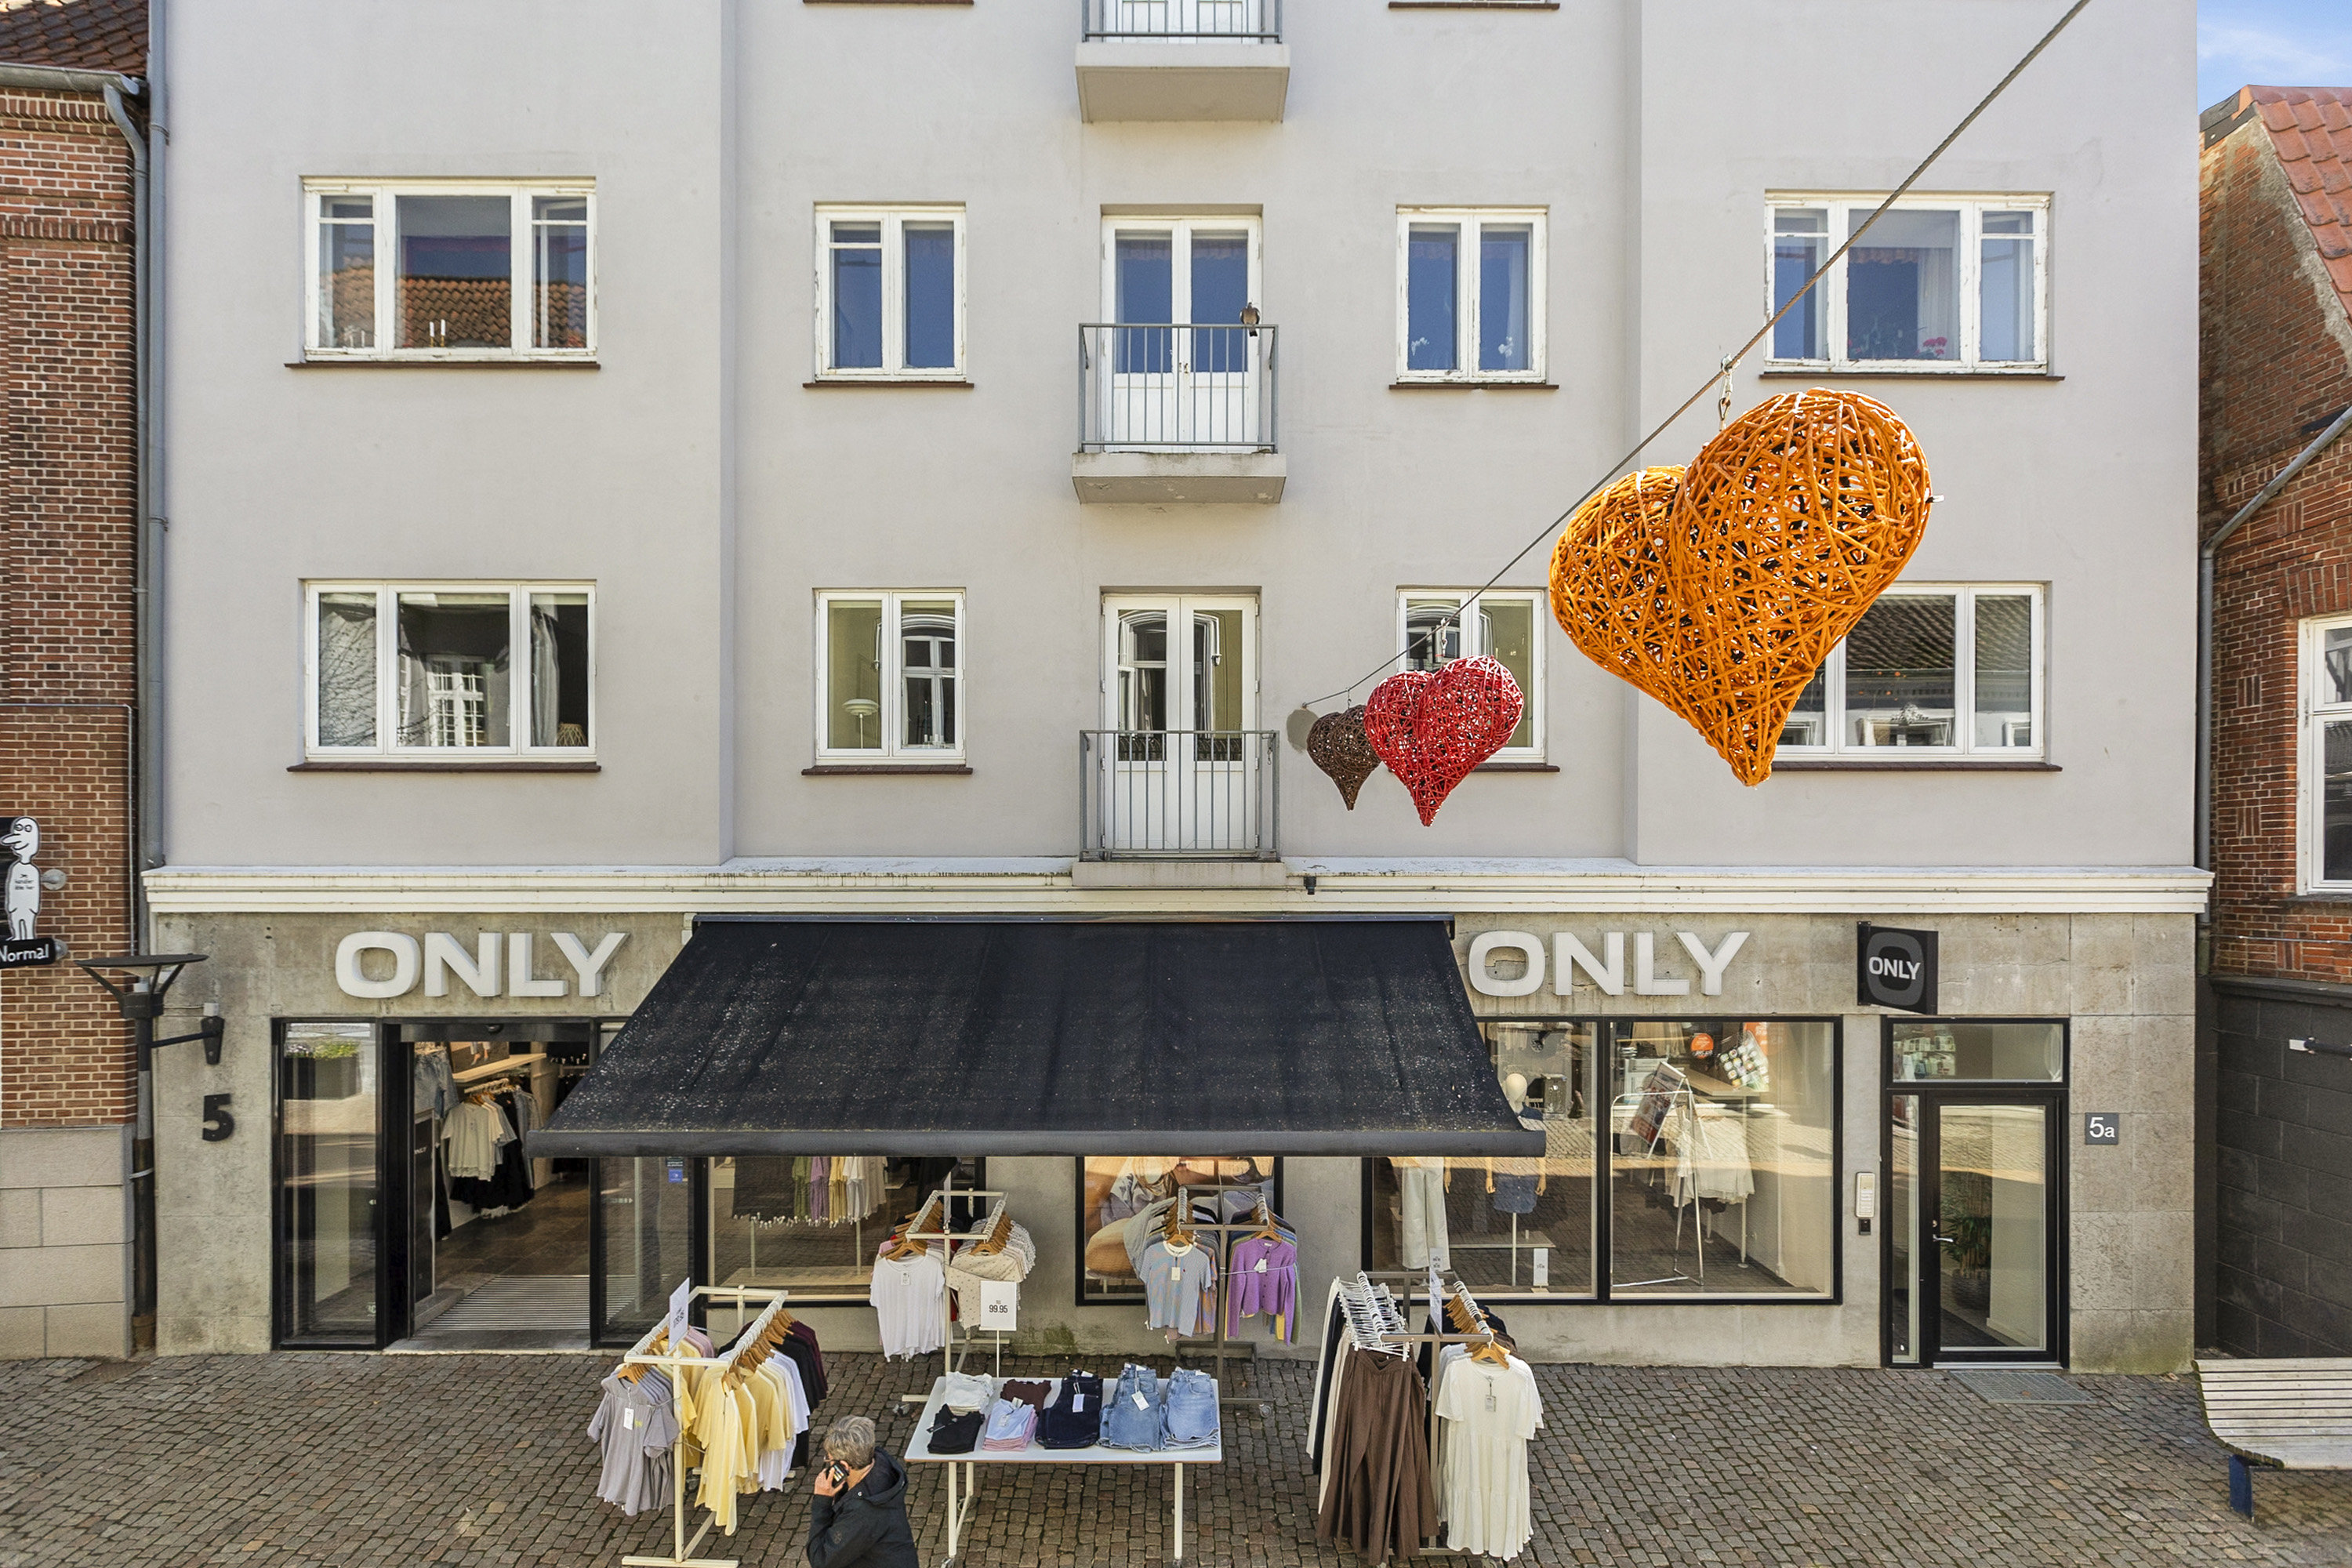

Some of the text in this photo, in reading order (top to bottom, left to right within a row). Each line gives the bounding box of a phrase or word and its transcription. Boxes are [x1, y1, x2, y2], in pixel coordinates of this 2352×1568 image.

[0, 943, 49, 963] Normal
[335, 931, 630, 999] ONLY
[1468, 930, 1751, 997] ONLY
[1868, 956, 1922, 980] ONLY
[202, 1093, 235, 1142] 5
[2089, 1116, 2115, 1138] 5a
[989, 1304, 1008, 1313] 99.95
